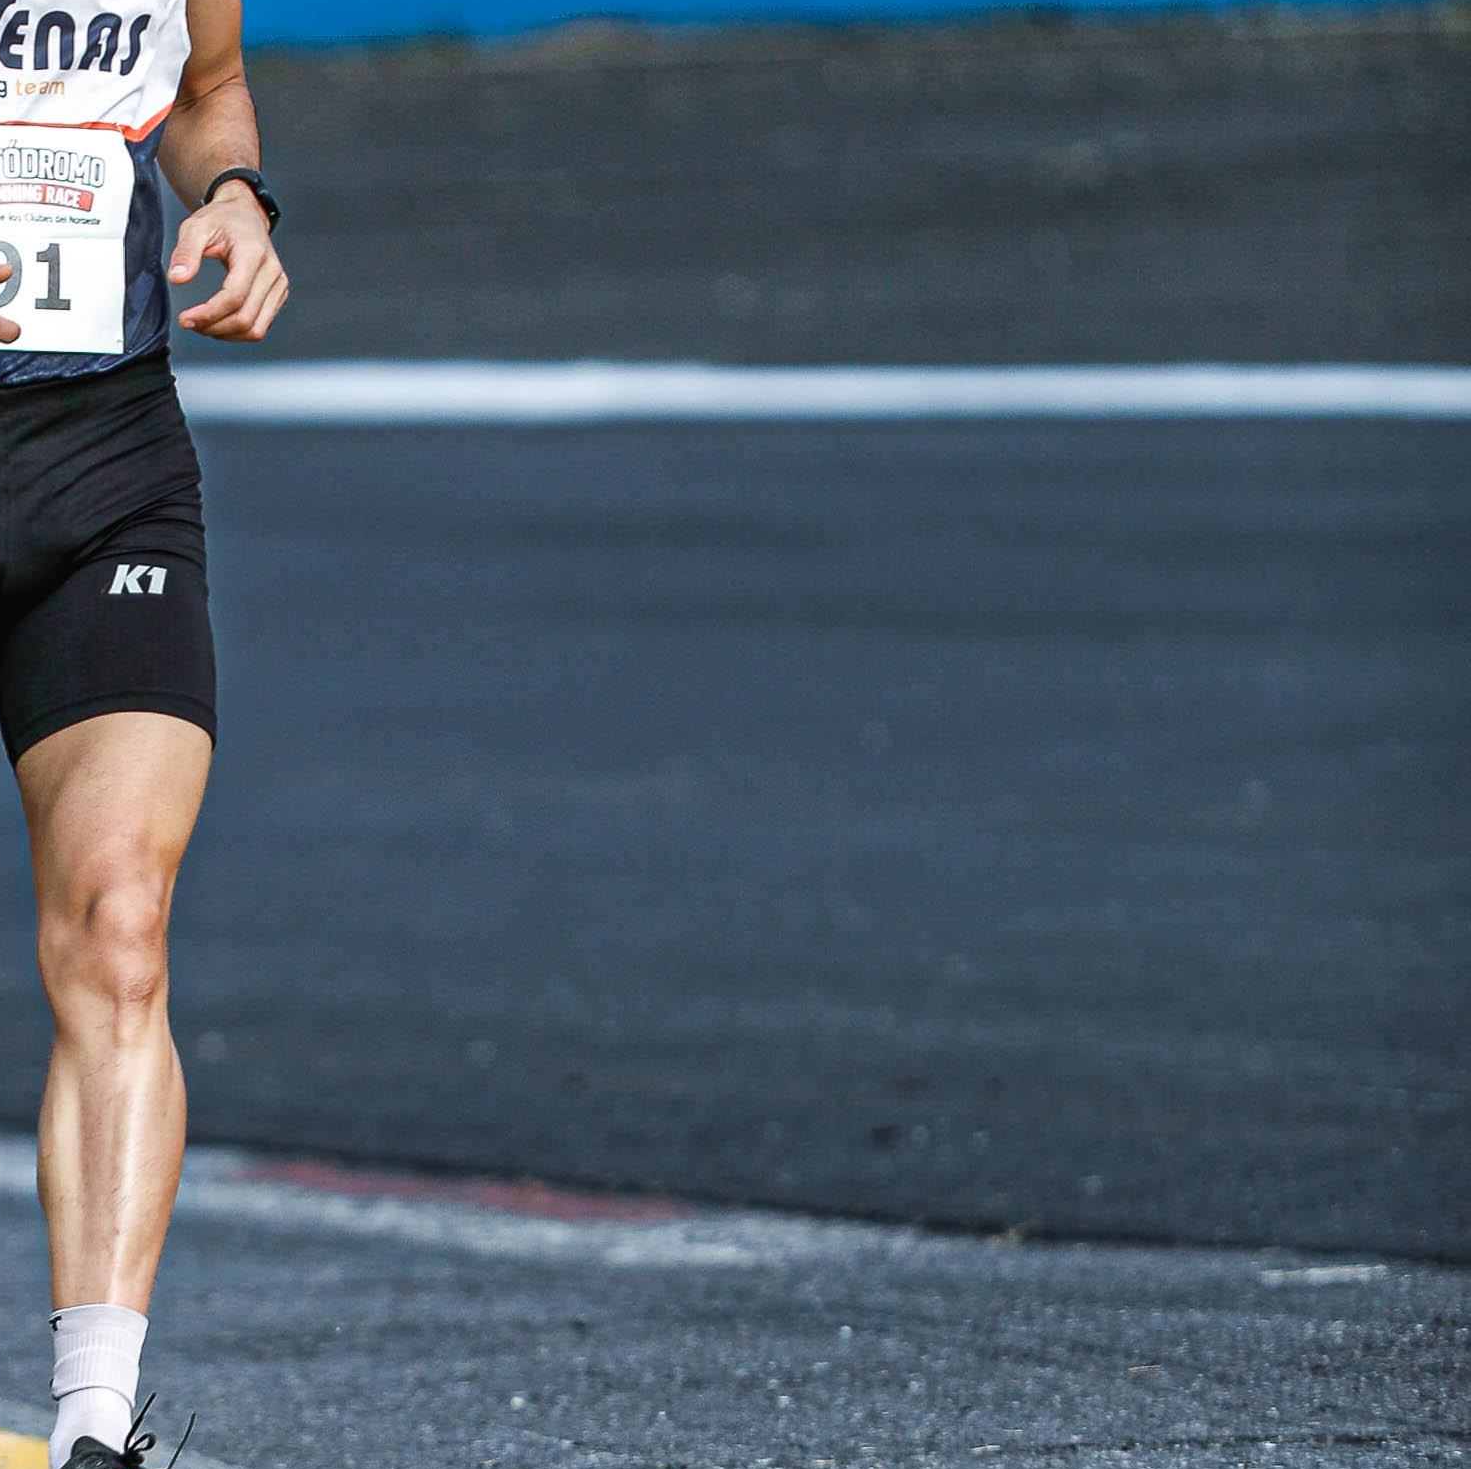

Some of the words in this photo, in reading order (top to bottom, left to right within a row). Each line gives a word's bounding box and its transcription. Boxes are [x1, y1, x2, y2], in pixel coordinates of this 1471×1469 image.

[15, 78, 65, 96] team
[45, 186, 82, 208] RACE
[8, 213, 22, 222] los
[25, 213, 53, 223] Clubes
[108, 564, 168, 595] K1
